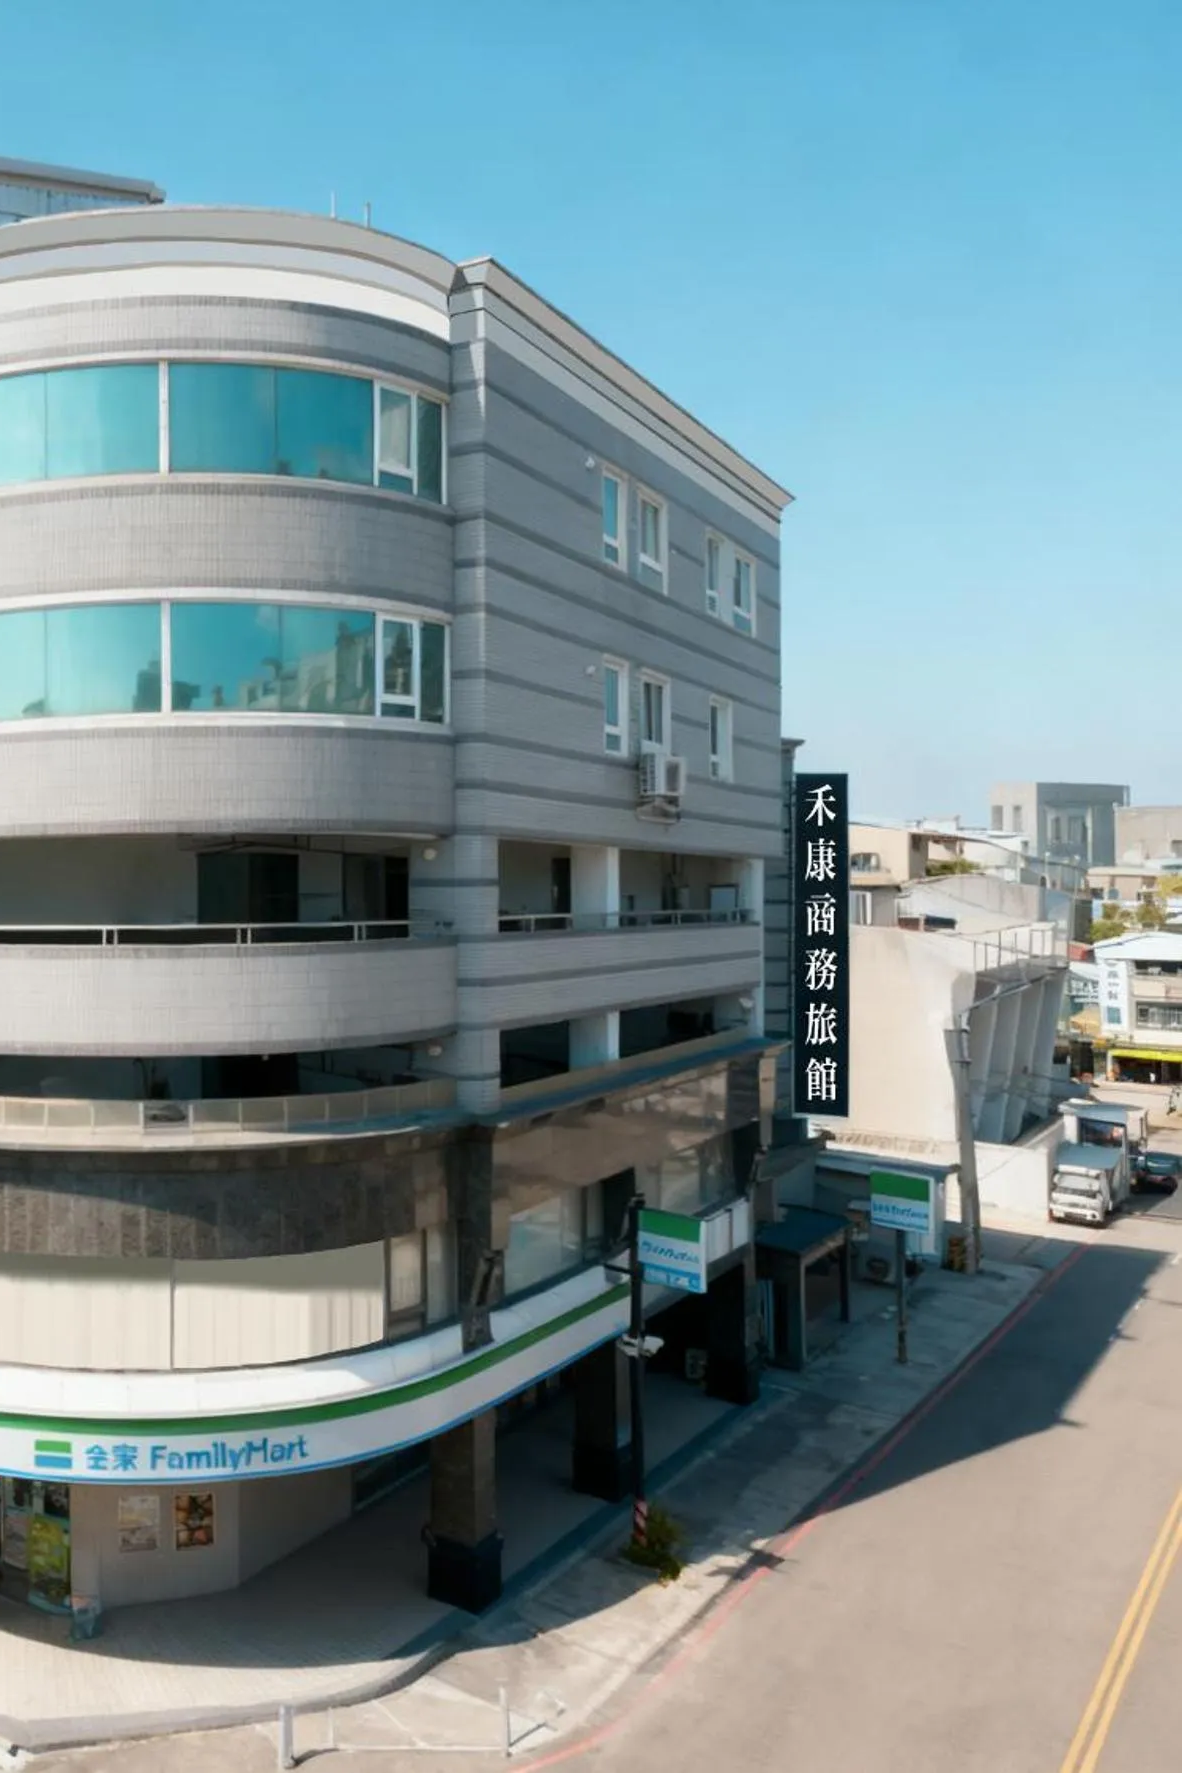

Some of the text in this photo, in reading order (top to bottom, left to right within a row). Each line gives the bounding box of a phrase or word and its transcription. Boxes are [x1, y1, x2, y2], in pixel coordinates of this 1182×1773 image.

[804, 783, 839, 1102] 禾康商務旅館
